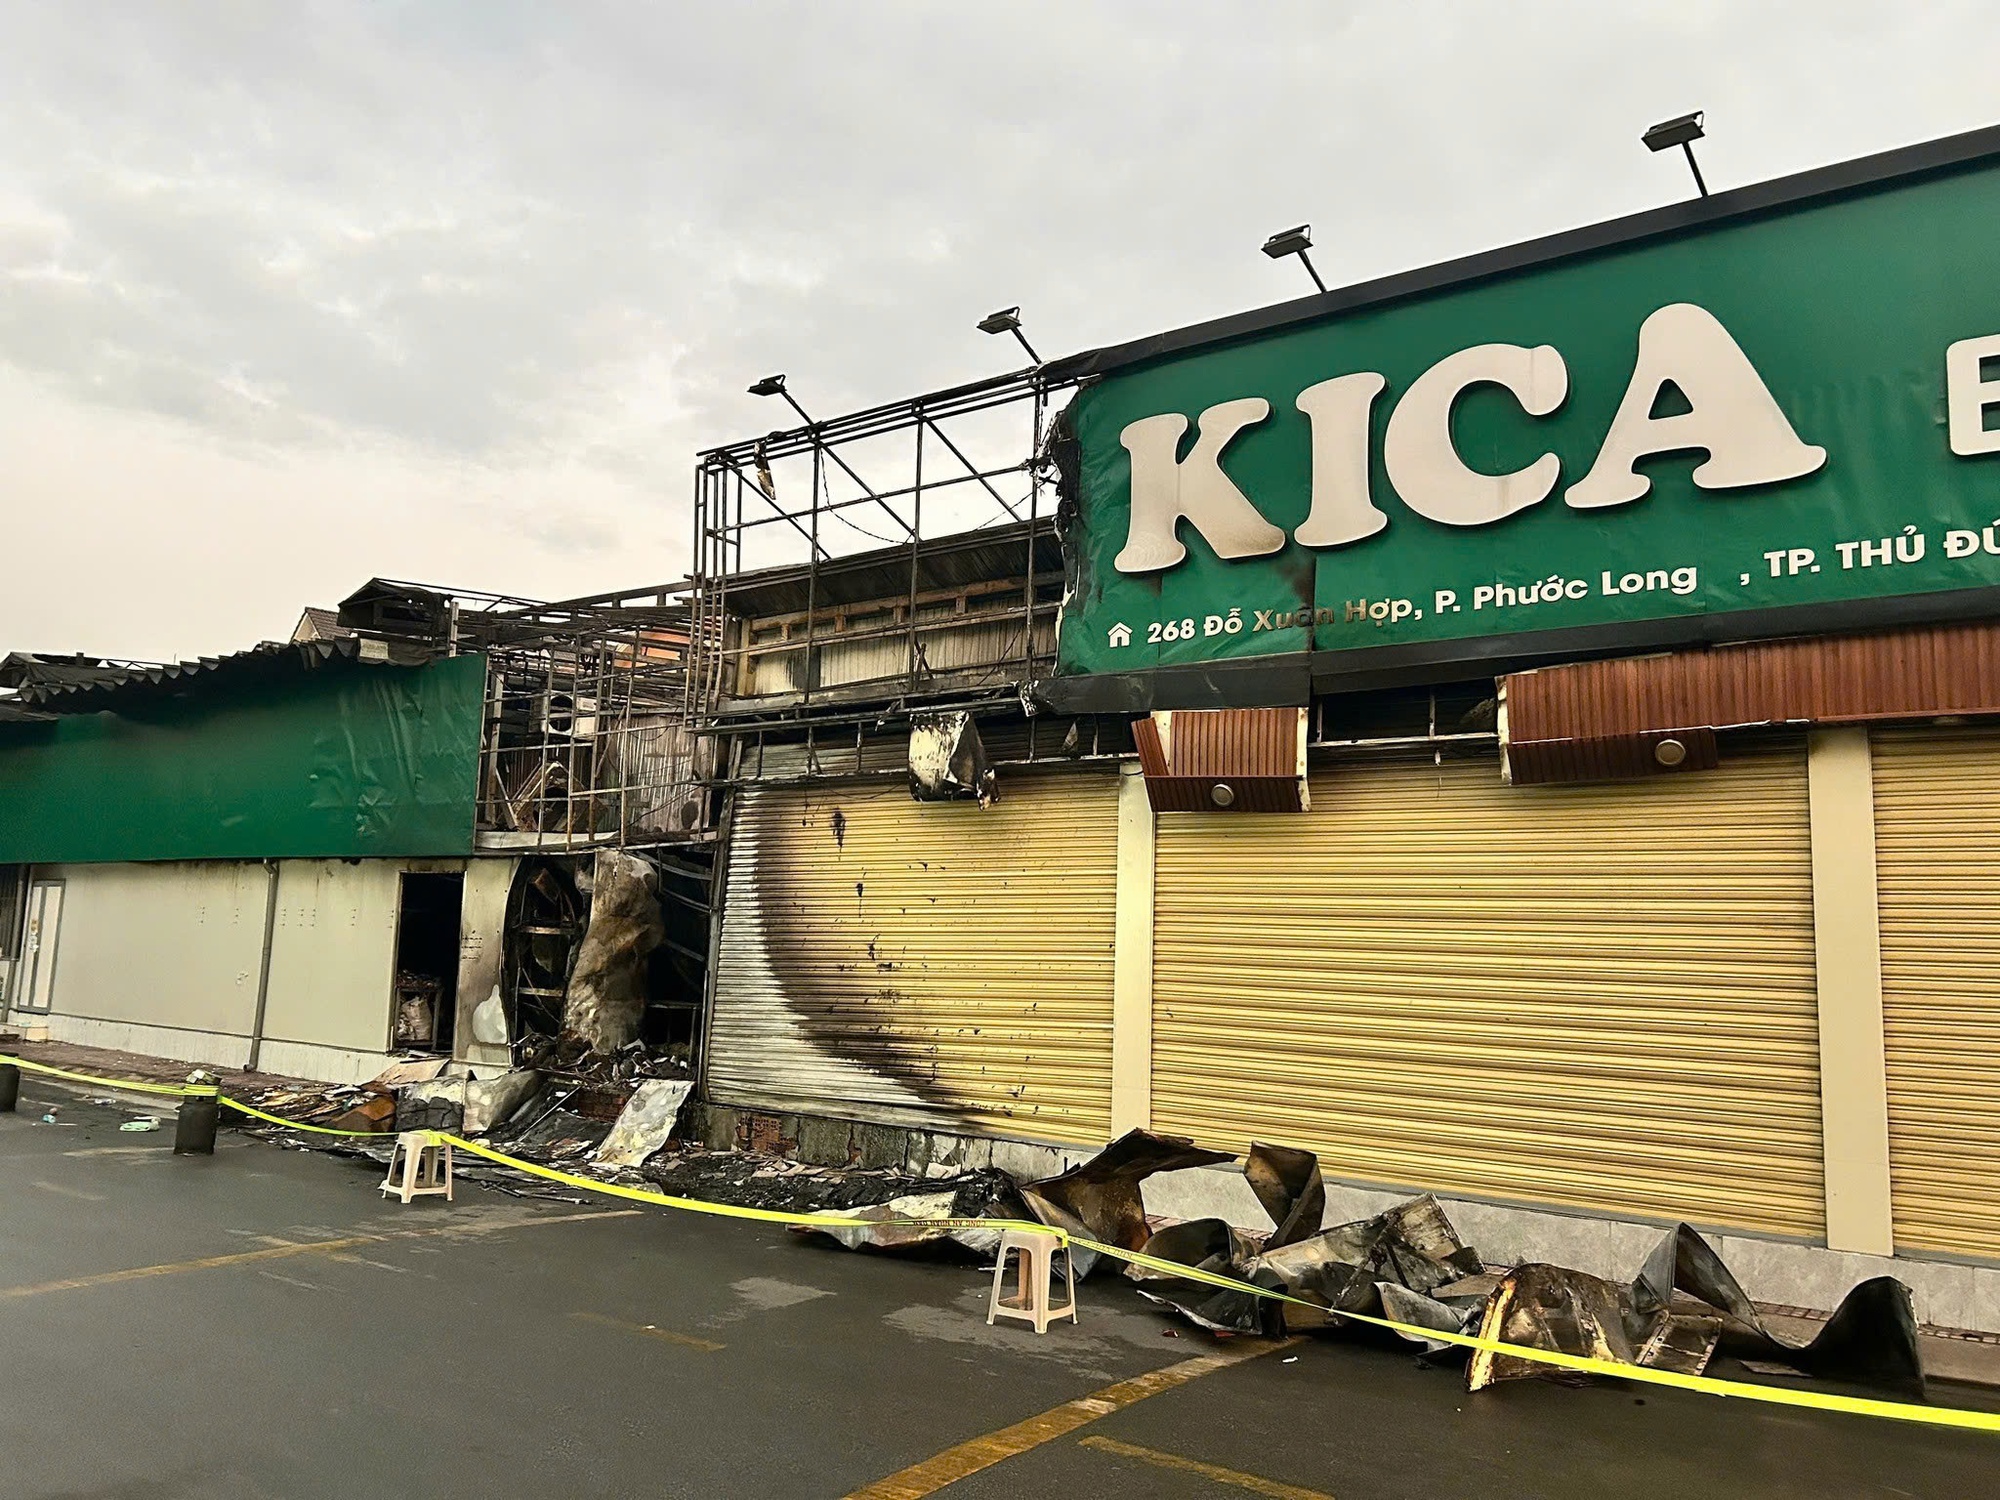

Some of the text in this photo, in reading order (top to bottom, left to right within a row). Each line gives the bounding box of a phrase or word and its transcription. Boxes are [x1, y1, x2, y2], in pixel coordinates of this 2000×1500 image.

[1114, 302, 1827, 574] KICA
[1147, 618, 1196, 645] 268
[1203, 606, 1243, 638] Đỗ
[1253, 605, 1335, 632] Xuân
[1346, 598, 1422, 627] Hợp,
[1435, 590, 1460, 613] P.
[1474, 574, 1588, 611] Phước
[1602, 566, 1697, 596] Long
[1764, 548, 1821, 577] TP.
[1836, 524, 1926, 570] THỦ
